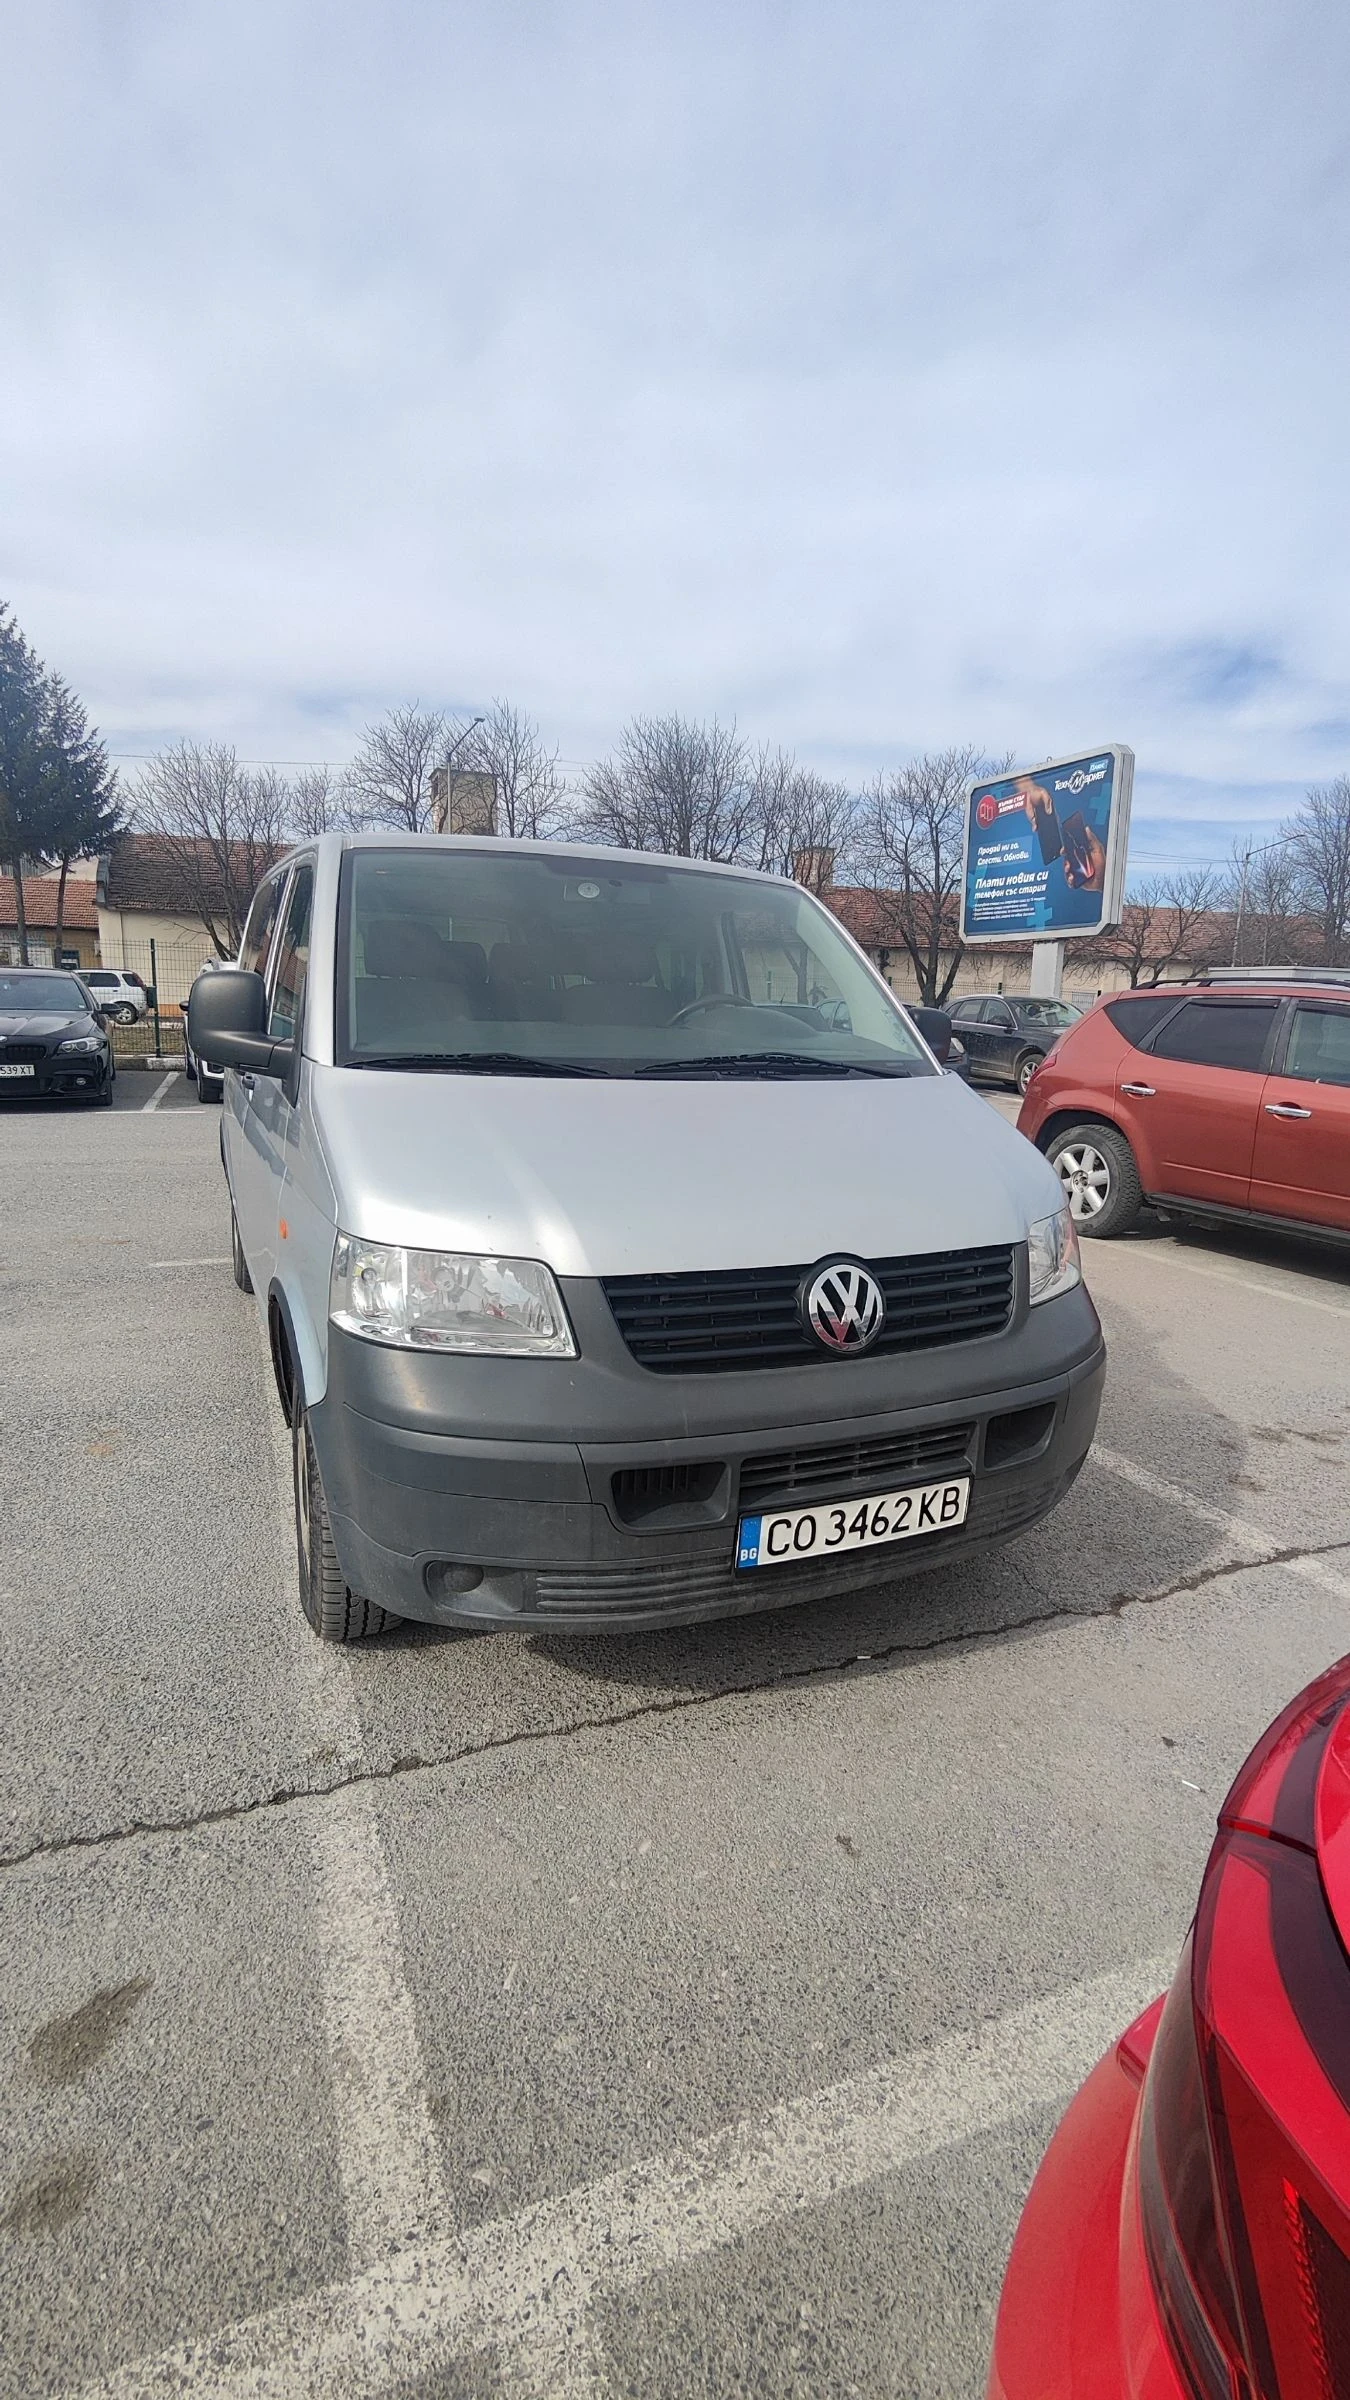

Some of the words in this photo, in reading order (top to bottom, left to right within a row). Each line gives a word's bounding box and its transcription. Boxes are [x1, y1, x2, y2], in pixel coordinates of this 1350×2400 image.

[977, 842, 1001, 856] Продай
[1001, 843, 1009, 851] ни
[975, 877, 1005, 889] Плати
[1006, 871, 1035, 885] новия
[1036, 871, 1049, 881] си
[974, 888, 1005, 900] телефон
[1005, 888, 1017, 896] със
[1018, 884, 1047, 895] стария
[767, 1514, 817, 1556] CO
[824, 1495, 913, 1546] 3462
[917, 1486, 960, 1528] KB
[740, 1548, 757, 1561] BG
